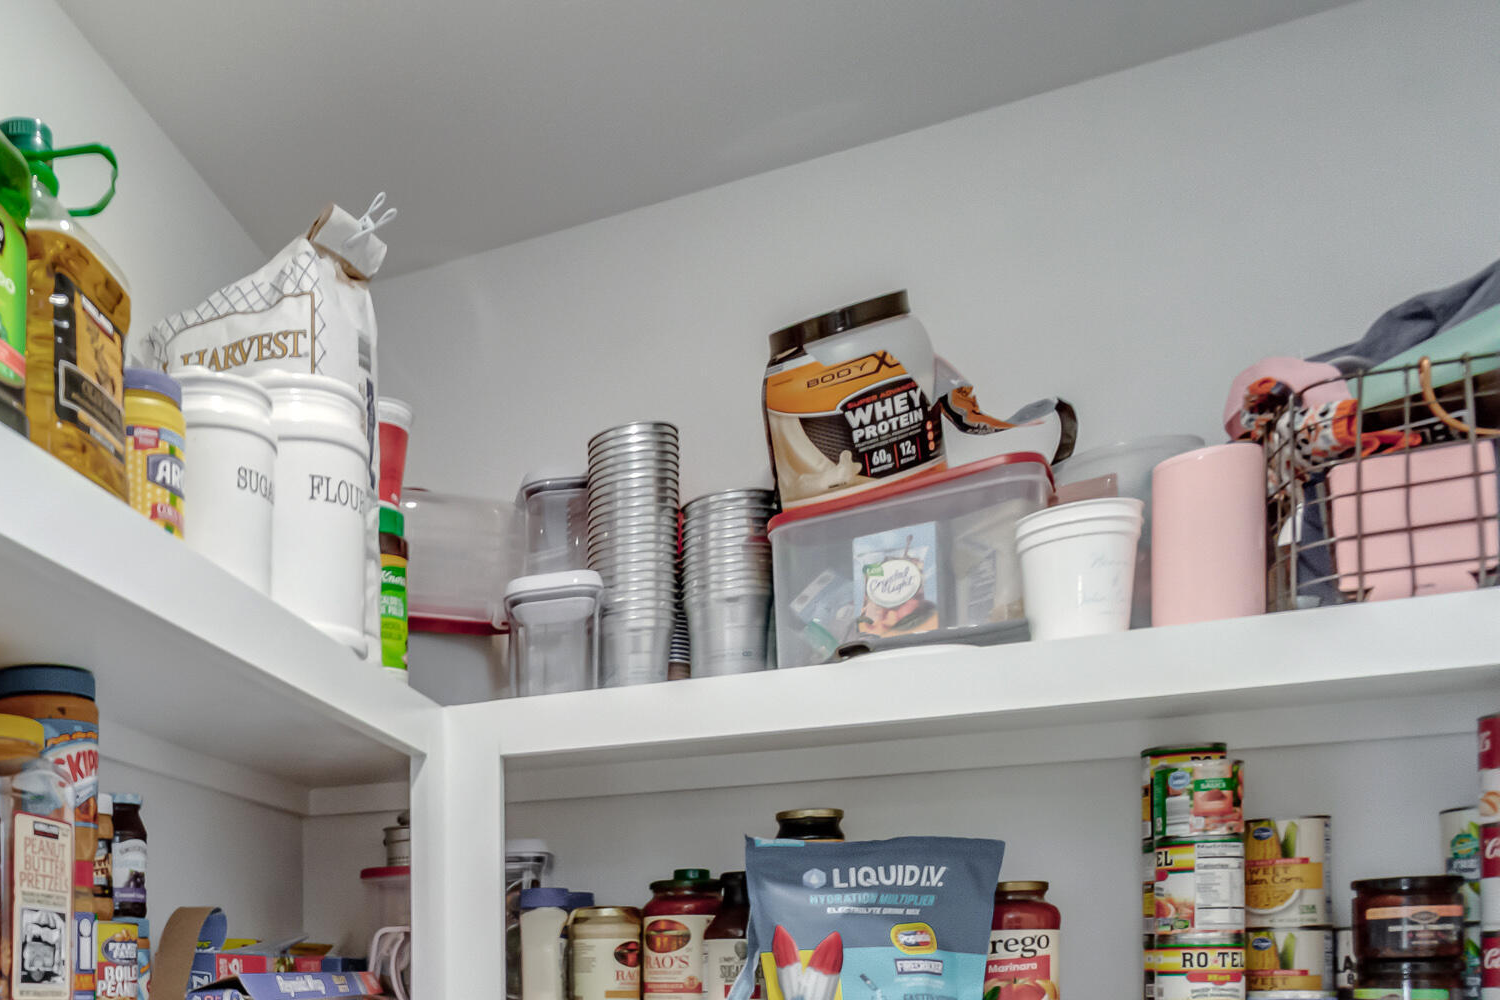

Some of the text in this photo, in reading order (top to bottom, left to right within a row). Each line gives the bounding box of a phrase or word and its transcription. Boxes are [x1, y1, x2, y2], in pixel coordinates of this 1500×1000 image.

[180, 328, 307, 372] HARVEST
[845, 388, 922, 428] WHEY
[852, 408, 923, 443] PROTEIN
[23, 837, 66, 863] PEANUT
[23, 856, 66, 882] BUTTER
[832, 865, 920, 888] LIQUID
[1249, 866, 1290, 876] WEET
[18, 871, 68, 894] PRETZELS
[809, 893, 936, 906] HYDRATION MULTIPLIER
[989, 935, 1050, 958] rego
[988, 962, 1037, 973] Marinara
[1250, 976, 1289, 986] WEET
